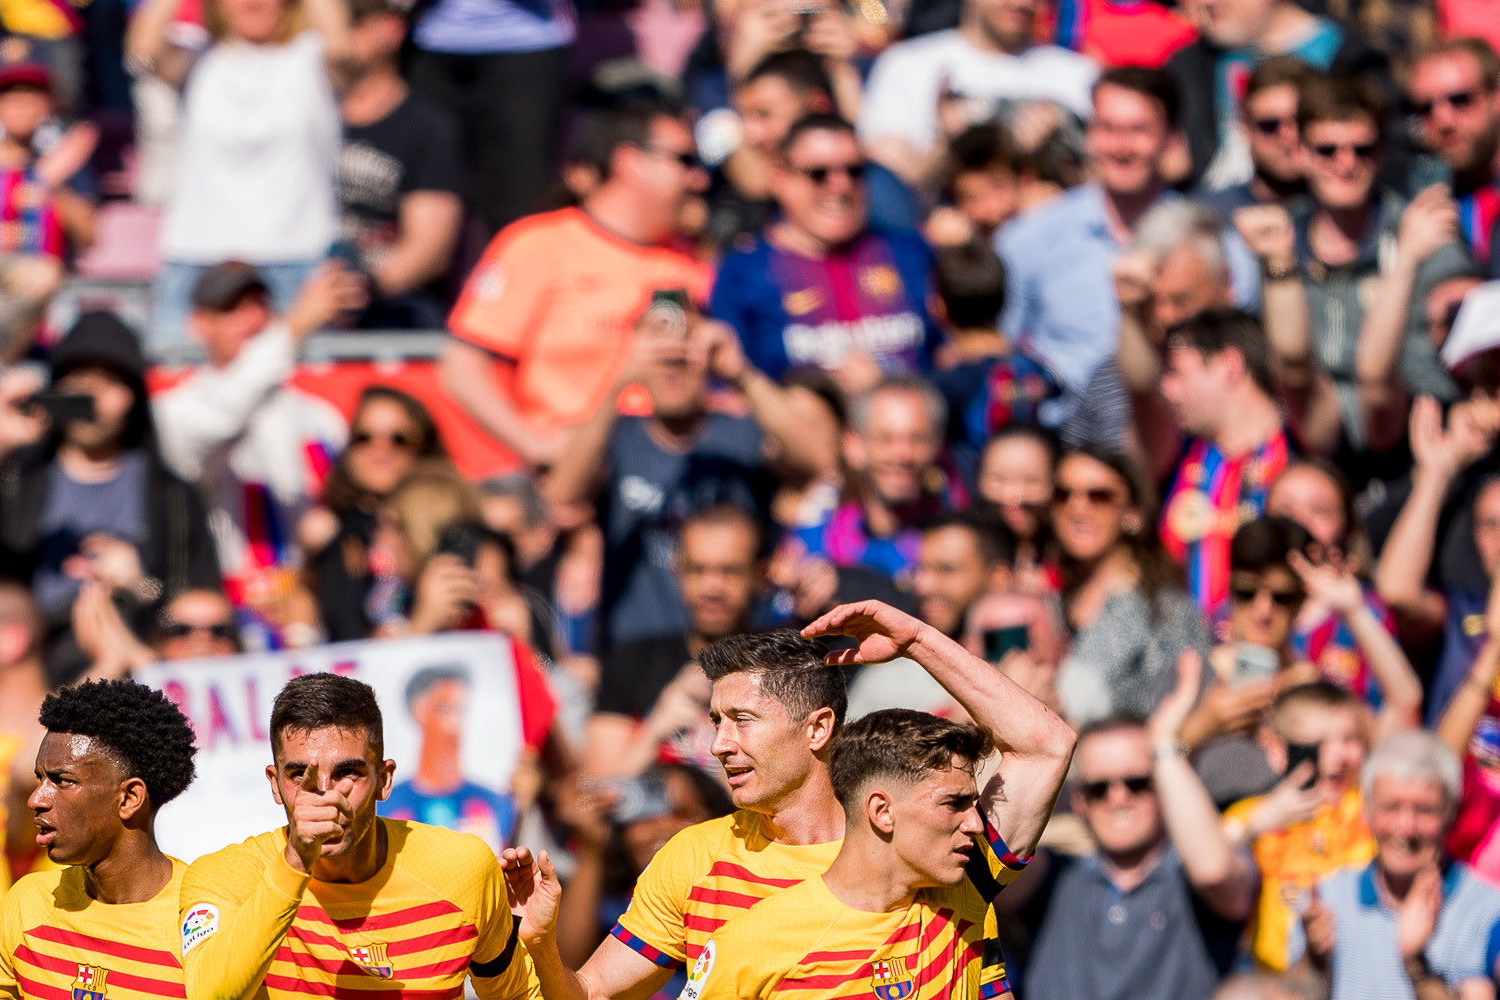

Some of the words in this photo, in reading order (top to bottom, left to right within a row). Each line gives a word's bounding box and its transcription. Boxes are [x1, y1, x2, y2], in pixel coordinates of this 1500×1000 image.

[183, 926, 214, 950] LaLiga
[883, 976, 900, 984] FCB
[83, 983, 97, 991] FCB
